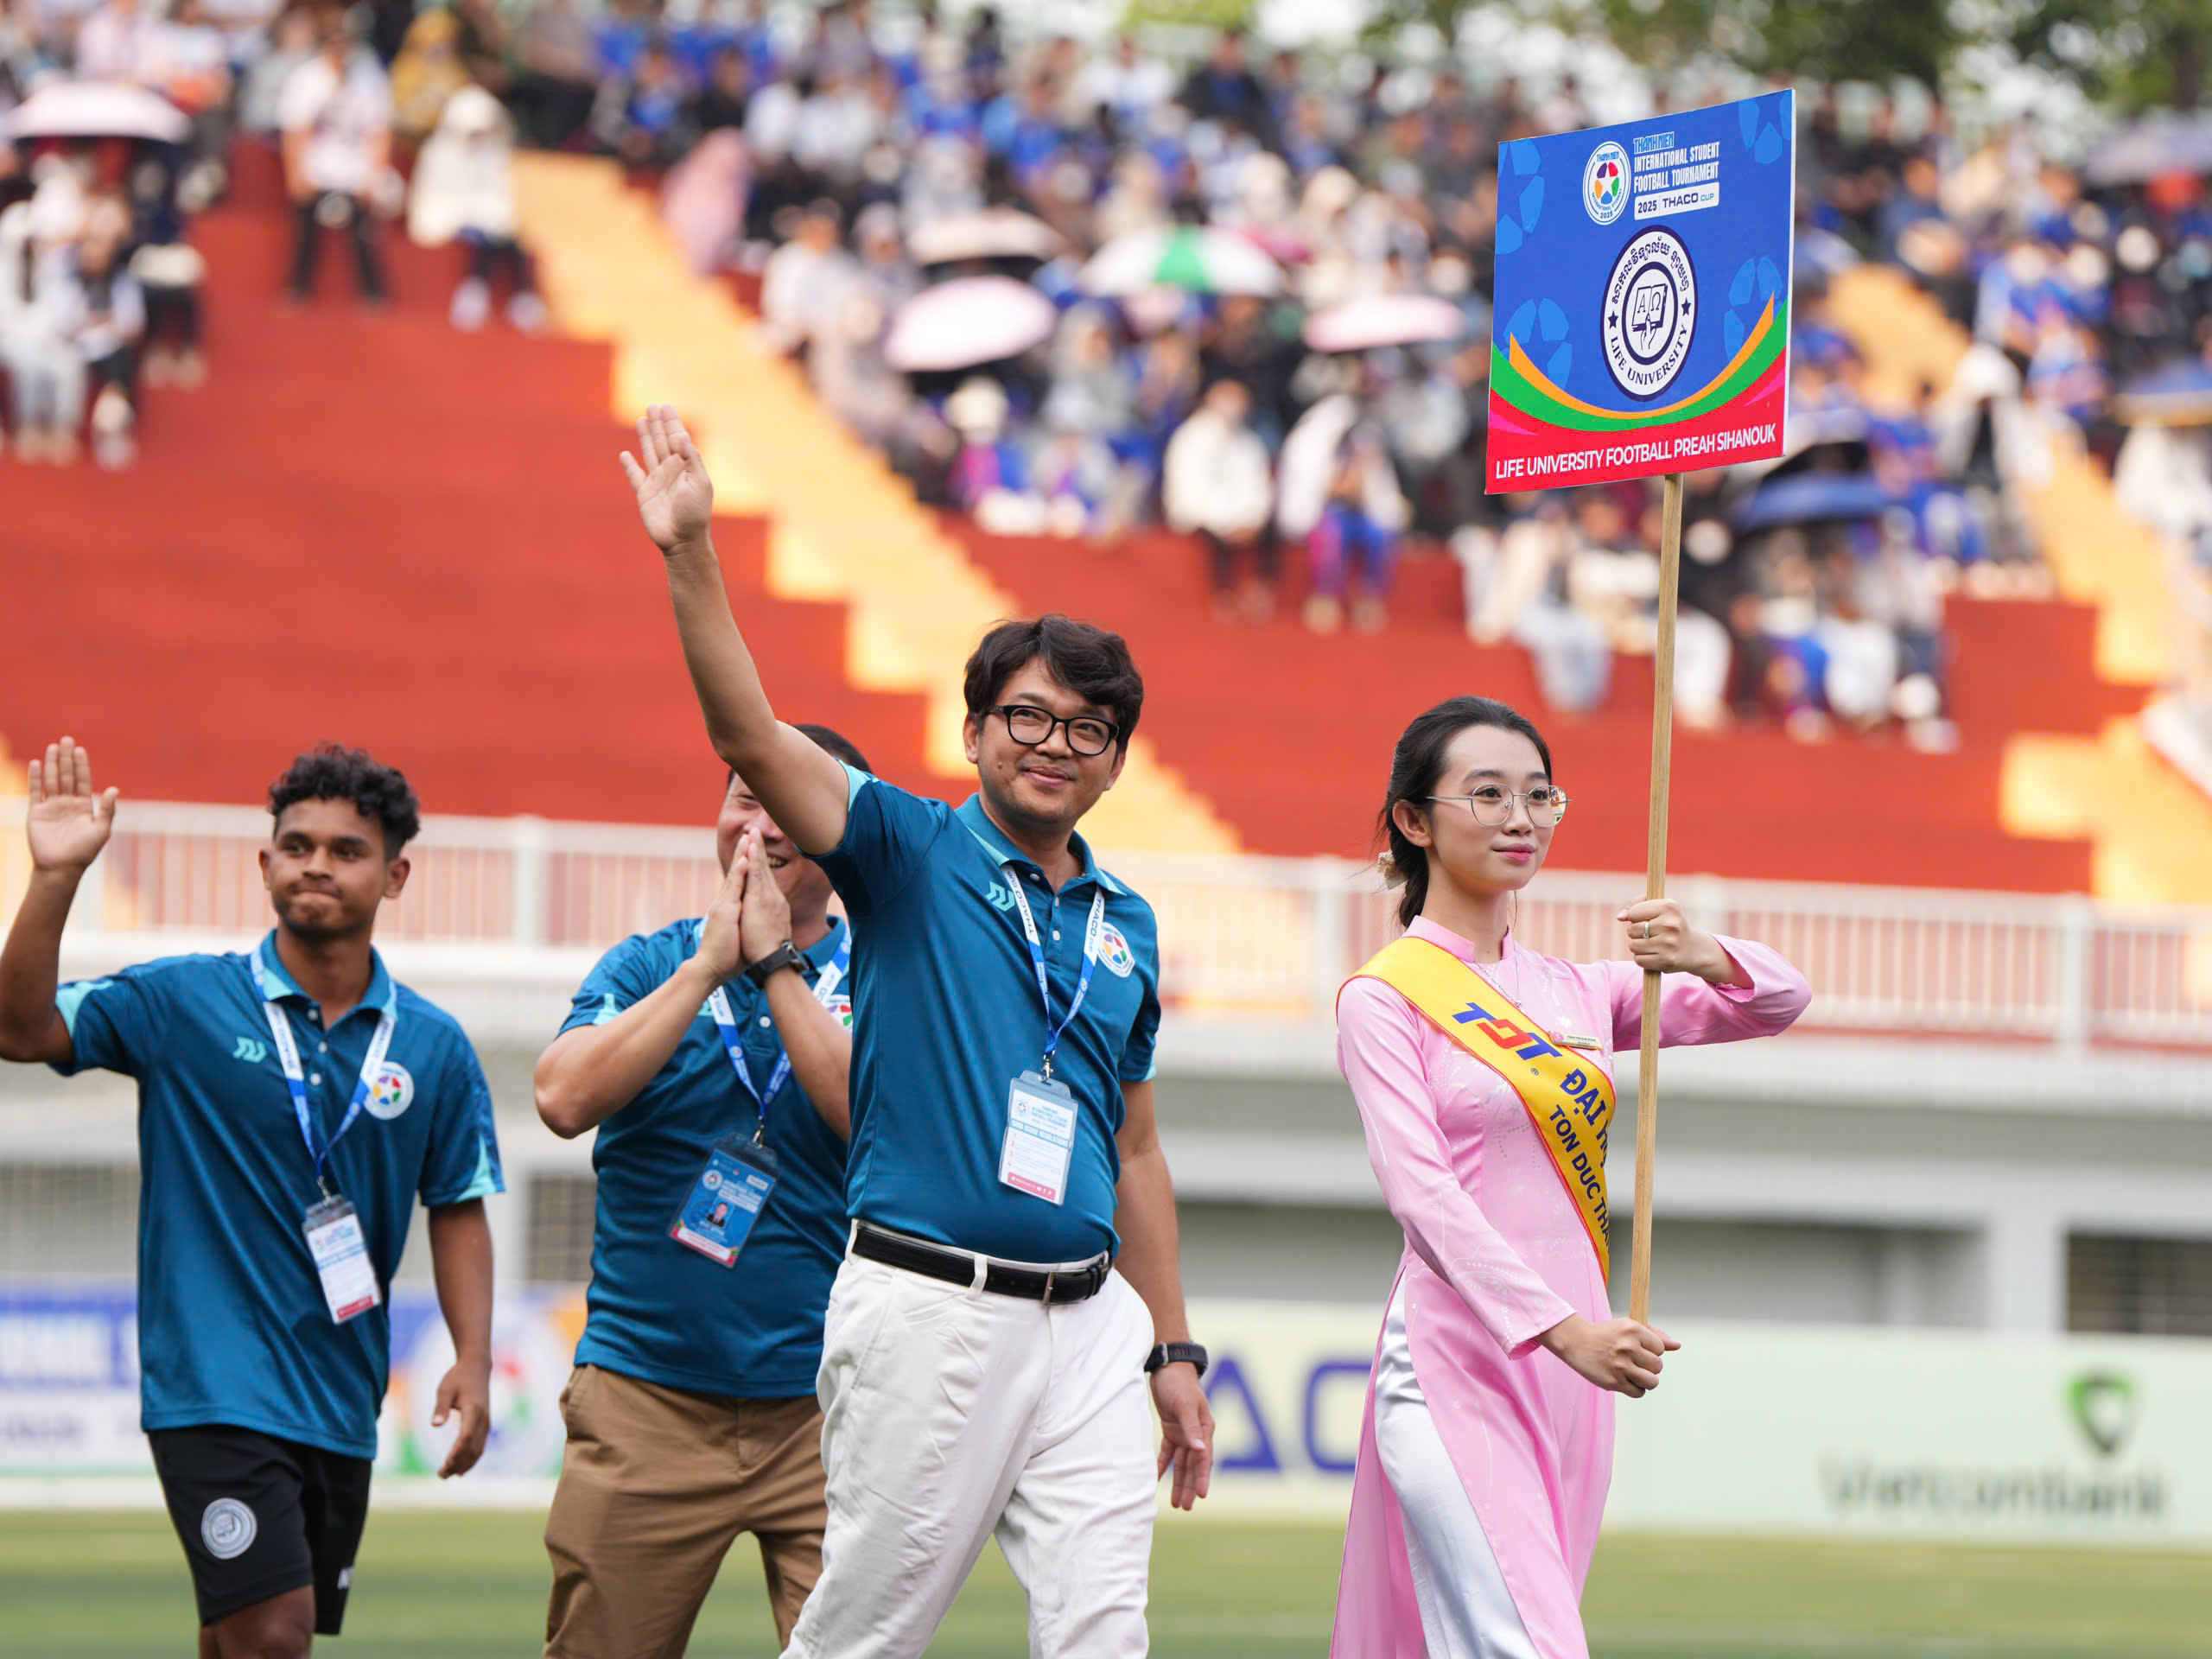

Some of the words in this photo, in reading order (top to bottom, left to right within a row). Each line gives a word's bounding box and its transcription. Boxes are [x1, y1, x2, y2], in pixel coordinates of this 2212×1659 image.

[1634, 148, 1688, 173] INTERNATIONAL
[1689, 141, 1720, 162] STUDENT
[1633, 170, 1670, 194] FOOTBALL
[1671, 161, 1719, 187] TOURNAMENT
[1592, 192, 1611, 212] INTERNATIONAL
[1599, 210, 1613, 219] 2025
[1637, 200, 1657, 214] 2025
[1662, 193, 1699, 208] THACO
[1700, 193, 1714, 201] CUP
[1611, 335, 1626, 371] LIFE
[1627, 322, 1688, 385] UNIVERSITY
[1495, 458, 1524, 480] LIFE
[1527, 448, 1605, 476] UNIVERSITY
[1605, 442, 1672, 467] FOOTBALL
[1674, 431, 1716, 459] PREAH
[1717, 423, 1777, 452] SIHANOUK
[1559, 1068, 1607, 1127] ĐẠI
[1549, 1103, 1580, 1154] TON
[1571, 1152, 1601, 1200] DUC
